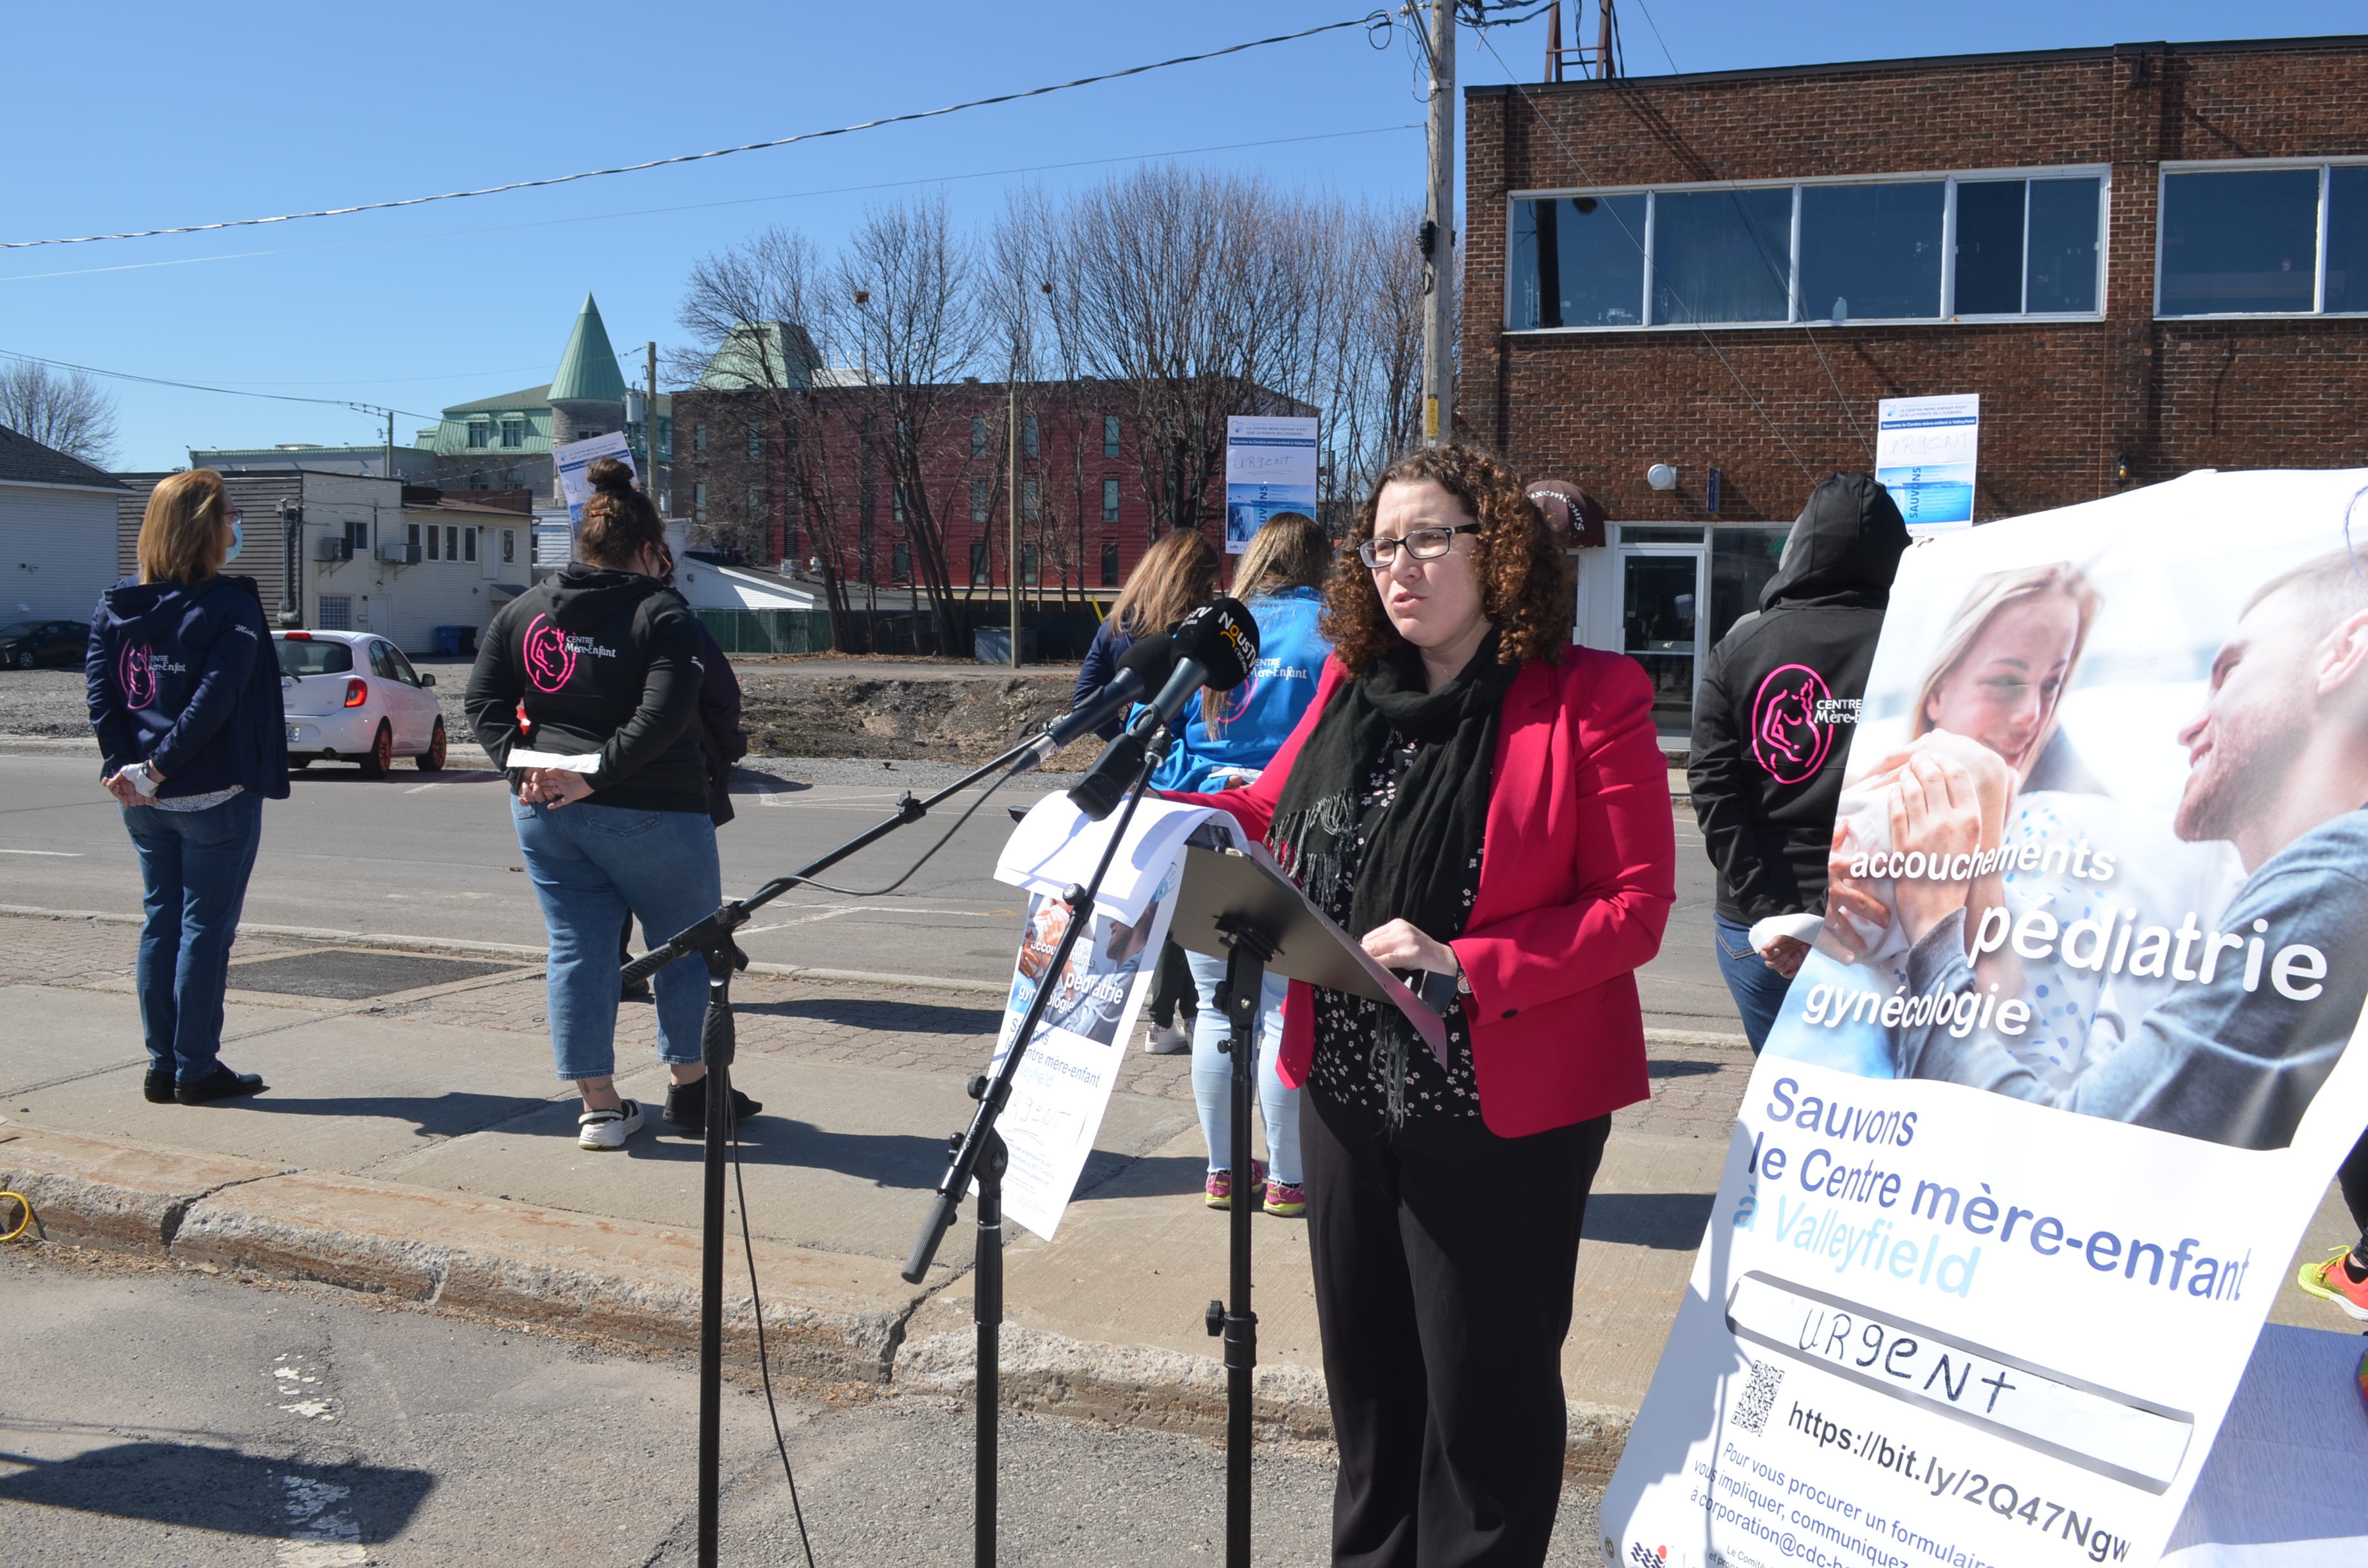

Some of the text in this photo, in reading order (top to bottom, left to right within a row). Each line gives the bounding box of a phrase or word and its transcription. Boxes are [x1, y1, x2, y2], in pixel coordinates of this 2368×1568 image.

[1260, 486, 1268, 524] UVONS
[1910, 468, 1921, 518] SAUVONS
[565, 643, 616, 658] Mère-Enfant
[566, 635, 595, 644] CENTRE
[1254, 658, 1281, 667] ENTRE
[1814, 709, 1861, 724] Mère-E
[1816, 699, 1862, 710] CENTRE
[1850, 839, 2116, 881] accouchements
[1030, 941, 1094, 967] accouments
[1967, 894, 2328, 1001] pédiatrie
[1064, 972, 1124, 1005] pédiatrie
[1802, 981, 2031, 1038] gynécologie
[1015, 1060, 1055, 1088] lleyfield
[1023, 1046, 1044, 1064] entre
[1045, 1054, 1101, 1088] mère-enfant
[1766, 1077, 1918, 1147] Sauvons
[1748, 1131, 2251, 1302] le Centre mère-enfant
[1732, 1184, 1982, 1298] à Valleyfield
[1723, 1442, 1750, 1468] Pour
[1752, 1460, 1786, 1486] vous
[1788, 1478, 1862, 1521] procurer
[1866, 1512, 1887, 1534] un
[1788, 1401, 2132, 1563] https://bit.ly/2Q47Ngw
[1691, 1485, 1850, 1568] à corporation@cdc-b
[1695, 1460, 1909, 1568] vous impliquer, communiquez
[1709, 1553, 1717, 1562] et
[1727, 1545, 1736, 1557] Le
